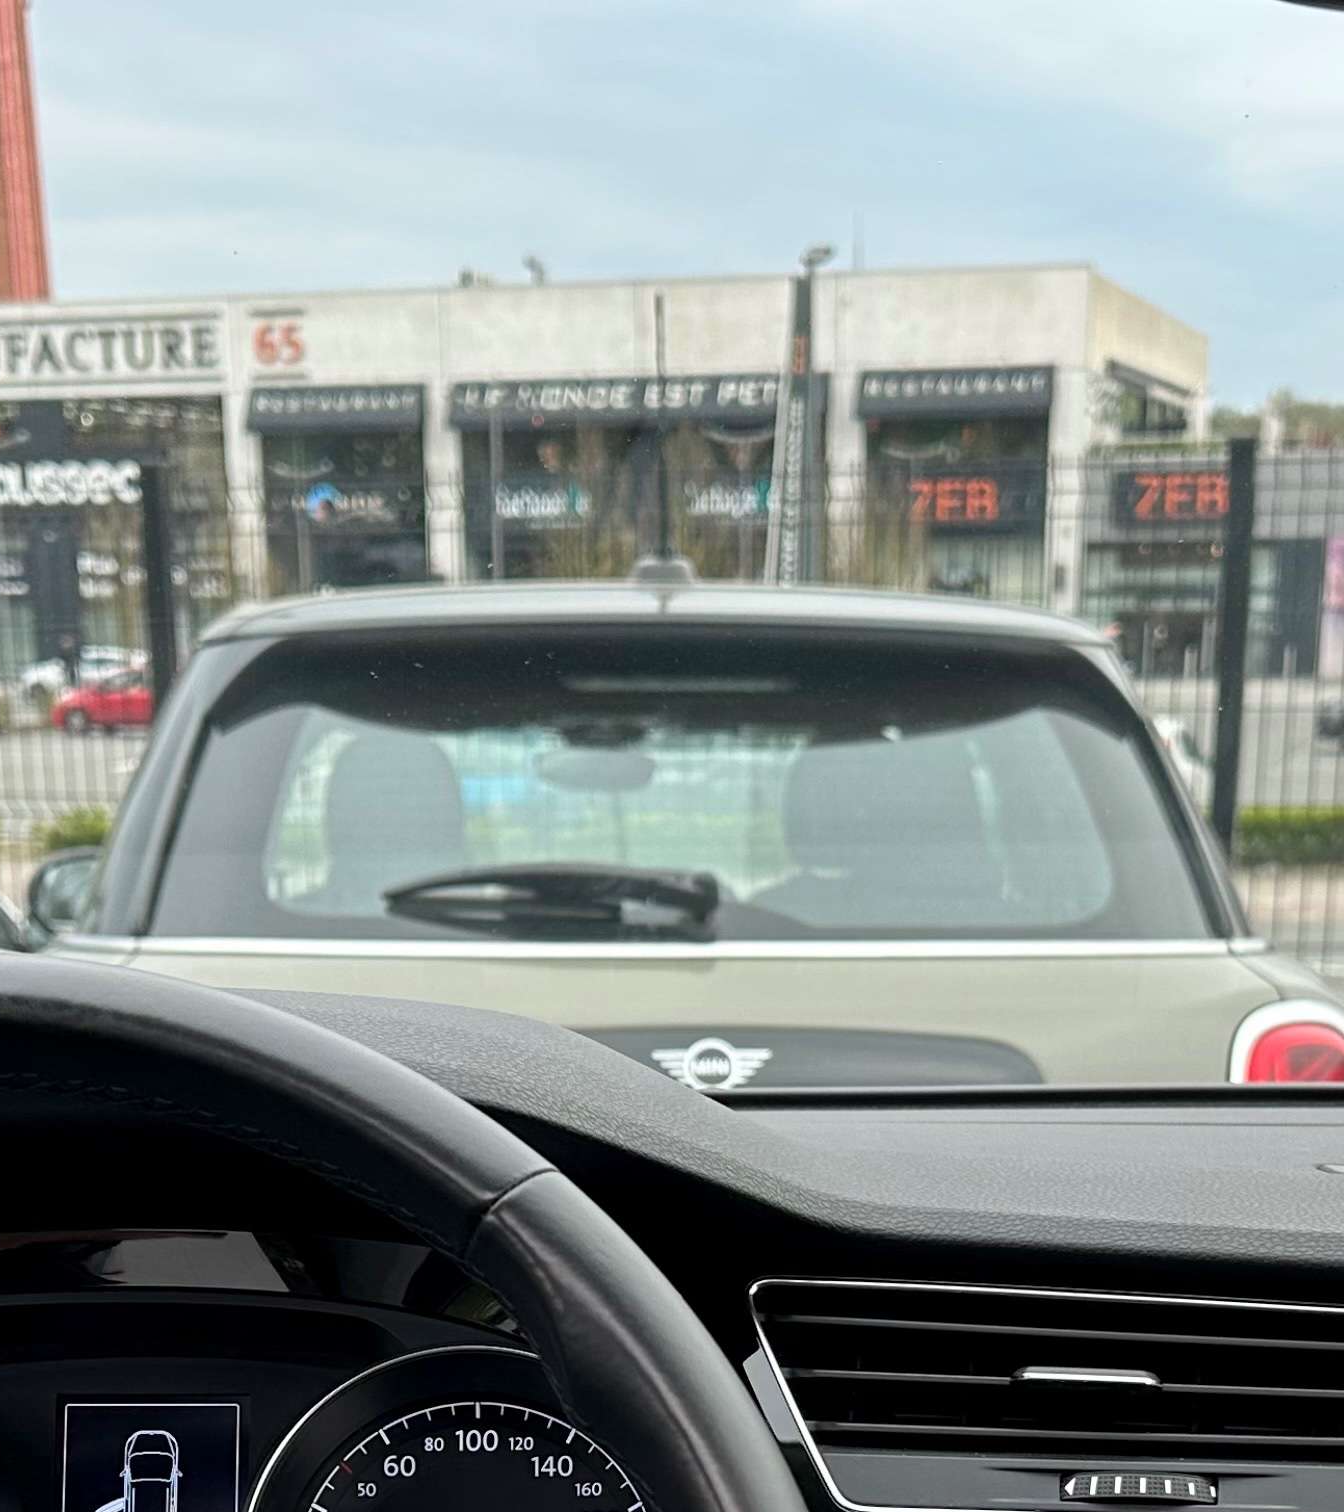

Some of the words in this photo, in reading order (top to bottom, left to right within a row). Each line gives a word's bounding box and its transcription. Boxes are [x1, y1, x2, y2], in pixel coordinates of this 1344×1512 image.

[254, 322, 304, 366] 65
[643, 381, 708, 407] EST
[716, 378, 777, 406] PET
[425, 1437, 444, 1451] 80
[456, 1430, 498, 1451] 100
[509, 1437, 533, 1450] 120
[384, 1456, 415, 1476] 60
[531, 1456, 572, 1476] 140
[358, 1483, 376, 1496] 50
[575, 1483, 601, 1496] 160
